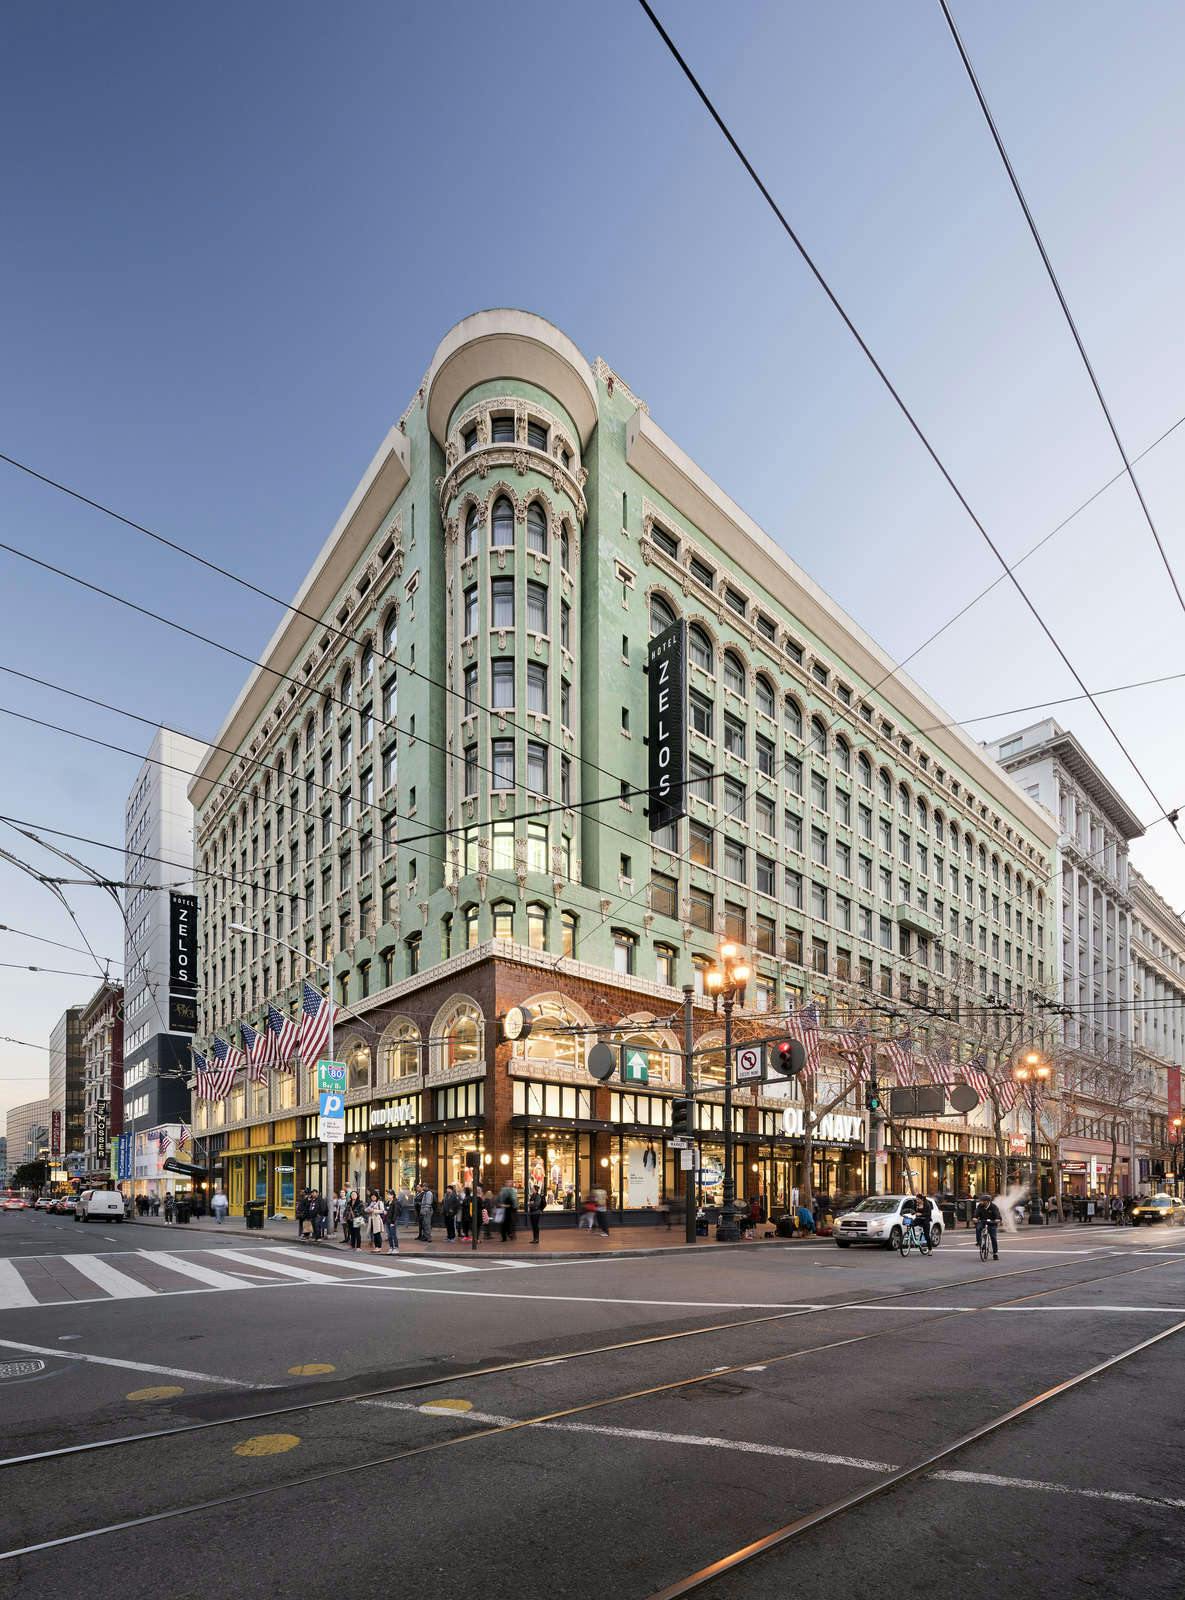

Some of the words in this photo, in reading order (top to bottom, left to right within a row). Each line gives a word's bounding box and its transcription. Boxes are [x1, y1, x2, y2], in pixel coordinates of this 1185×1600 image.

[651, 634, 677, 660] HOTEL
[658, 660, 670, 796] ZELOS
[173, 897, 194, 907] HOTEL
[178, 909, 188, 981] ZELOS
[331, 1069, 342, 1078] 80
[371, 1108, 386, 1126] OLD
[387, 1103, 411, 1124] NAVY
[820, 1113, 862, 1140] NAVY
